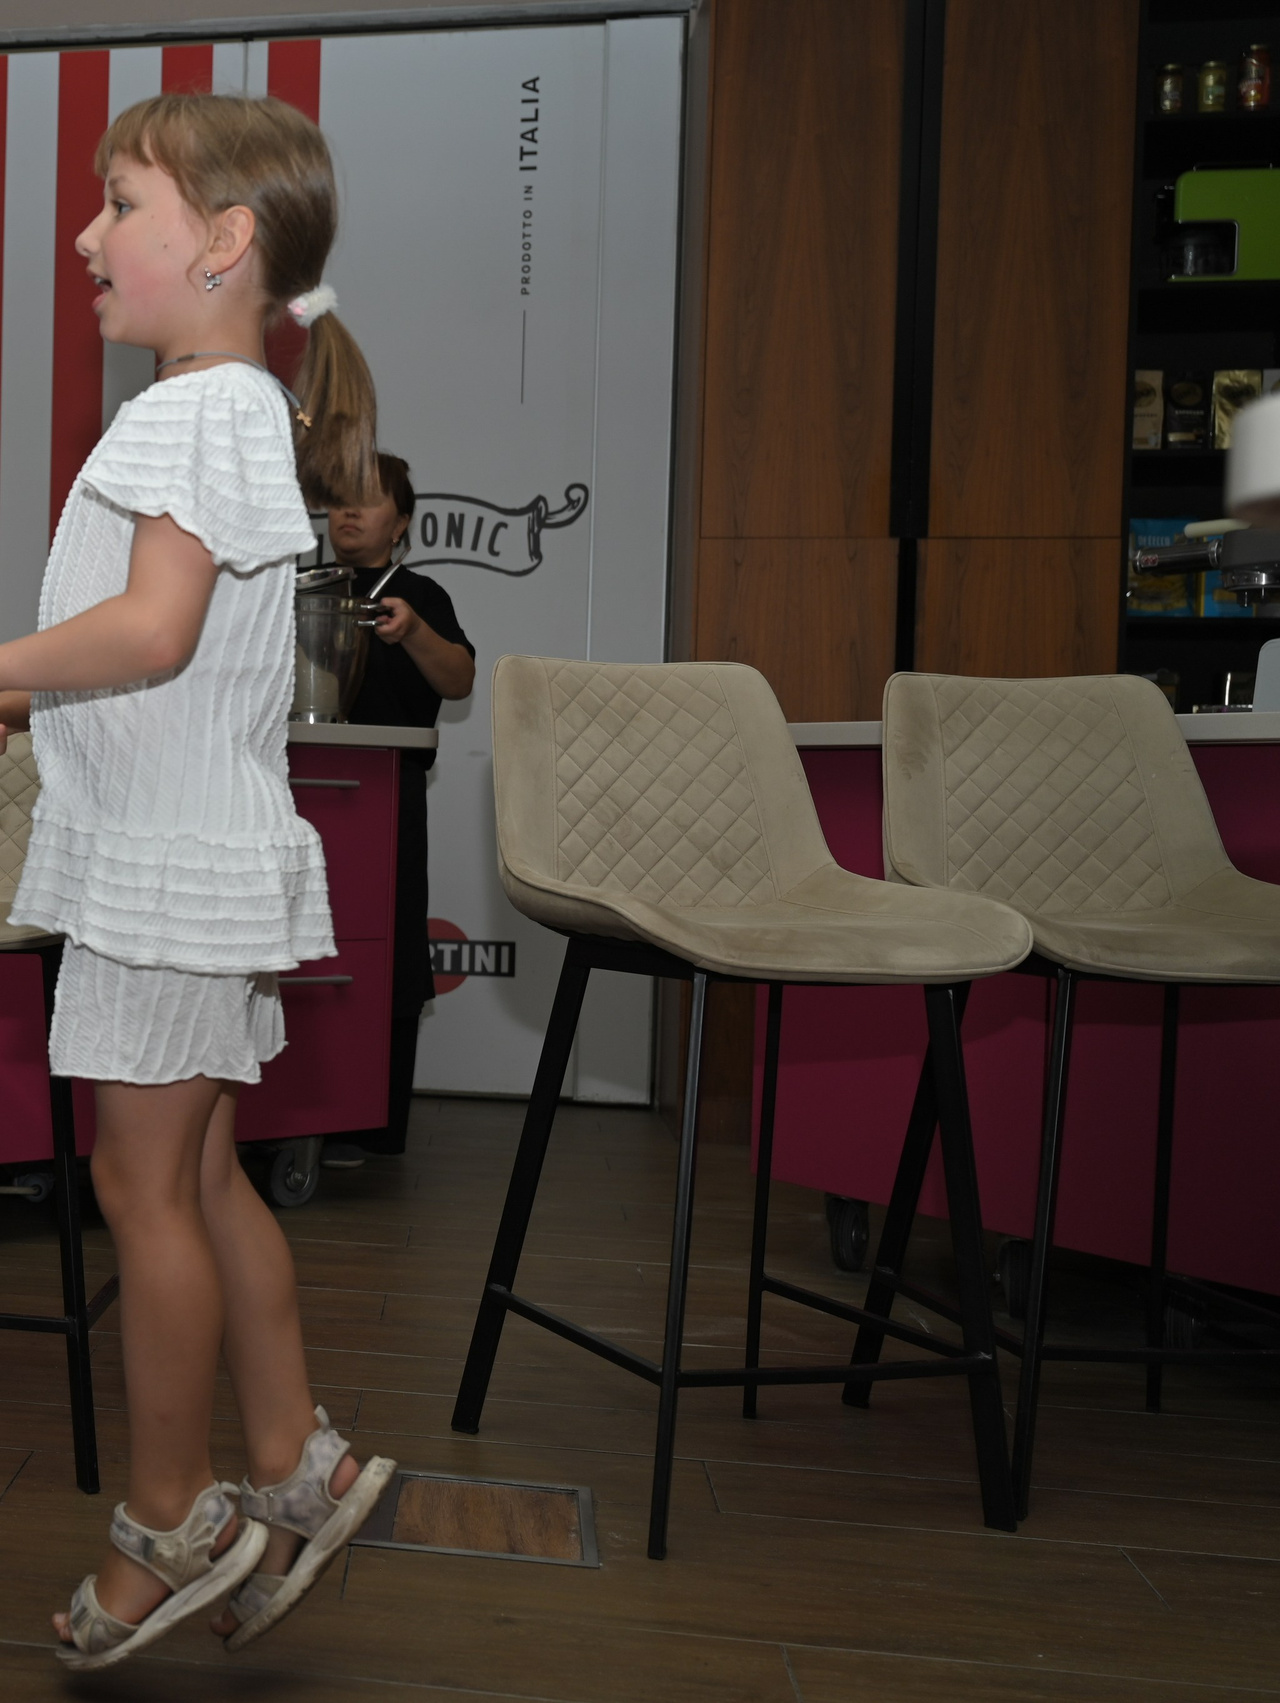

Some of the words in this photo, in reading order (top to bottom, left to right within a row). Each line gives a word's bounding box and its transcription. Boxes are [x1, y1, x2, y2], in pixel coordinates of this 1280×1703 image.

[519, 76, 540, 171] ITALIA
[523, 185, 534, 201] IN
[521, 210, 533, 296] PRODOTTO
[404, 511, 508, 557] ONIC
